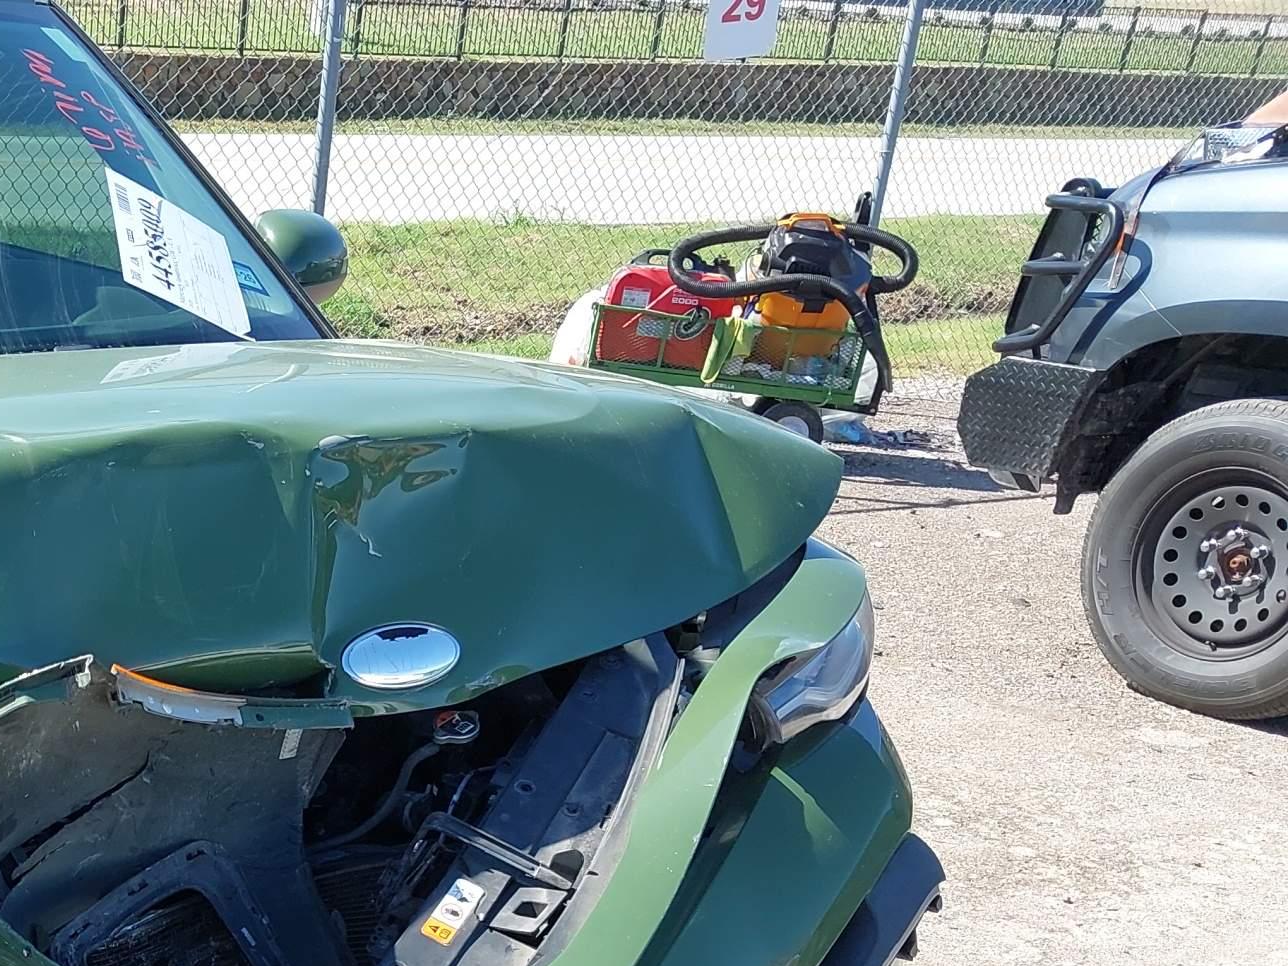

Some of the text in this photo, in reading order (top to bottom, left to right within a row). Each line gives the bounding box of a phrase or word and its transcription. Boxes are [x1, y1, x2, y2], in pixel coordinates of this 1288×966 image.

[721, 0, 766, 23] 29
[137, 198, 175, 291] 44585009
[672, 297, 699, 306] 2000
